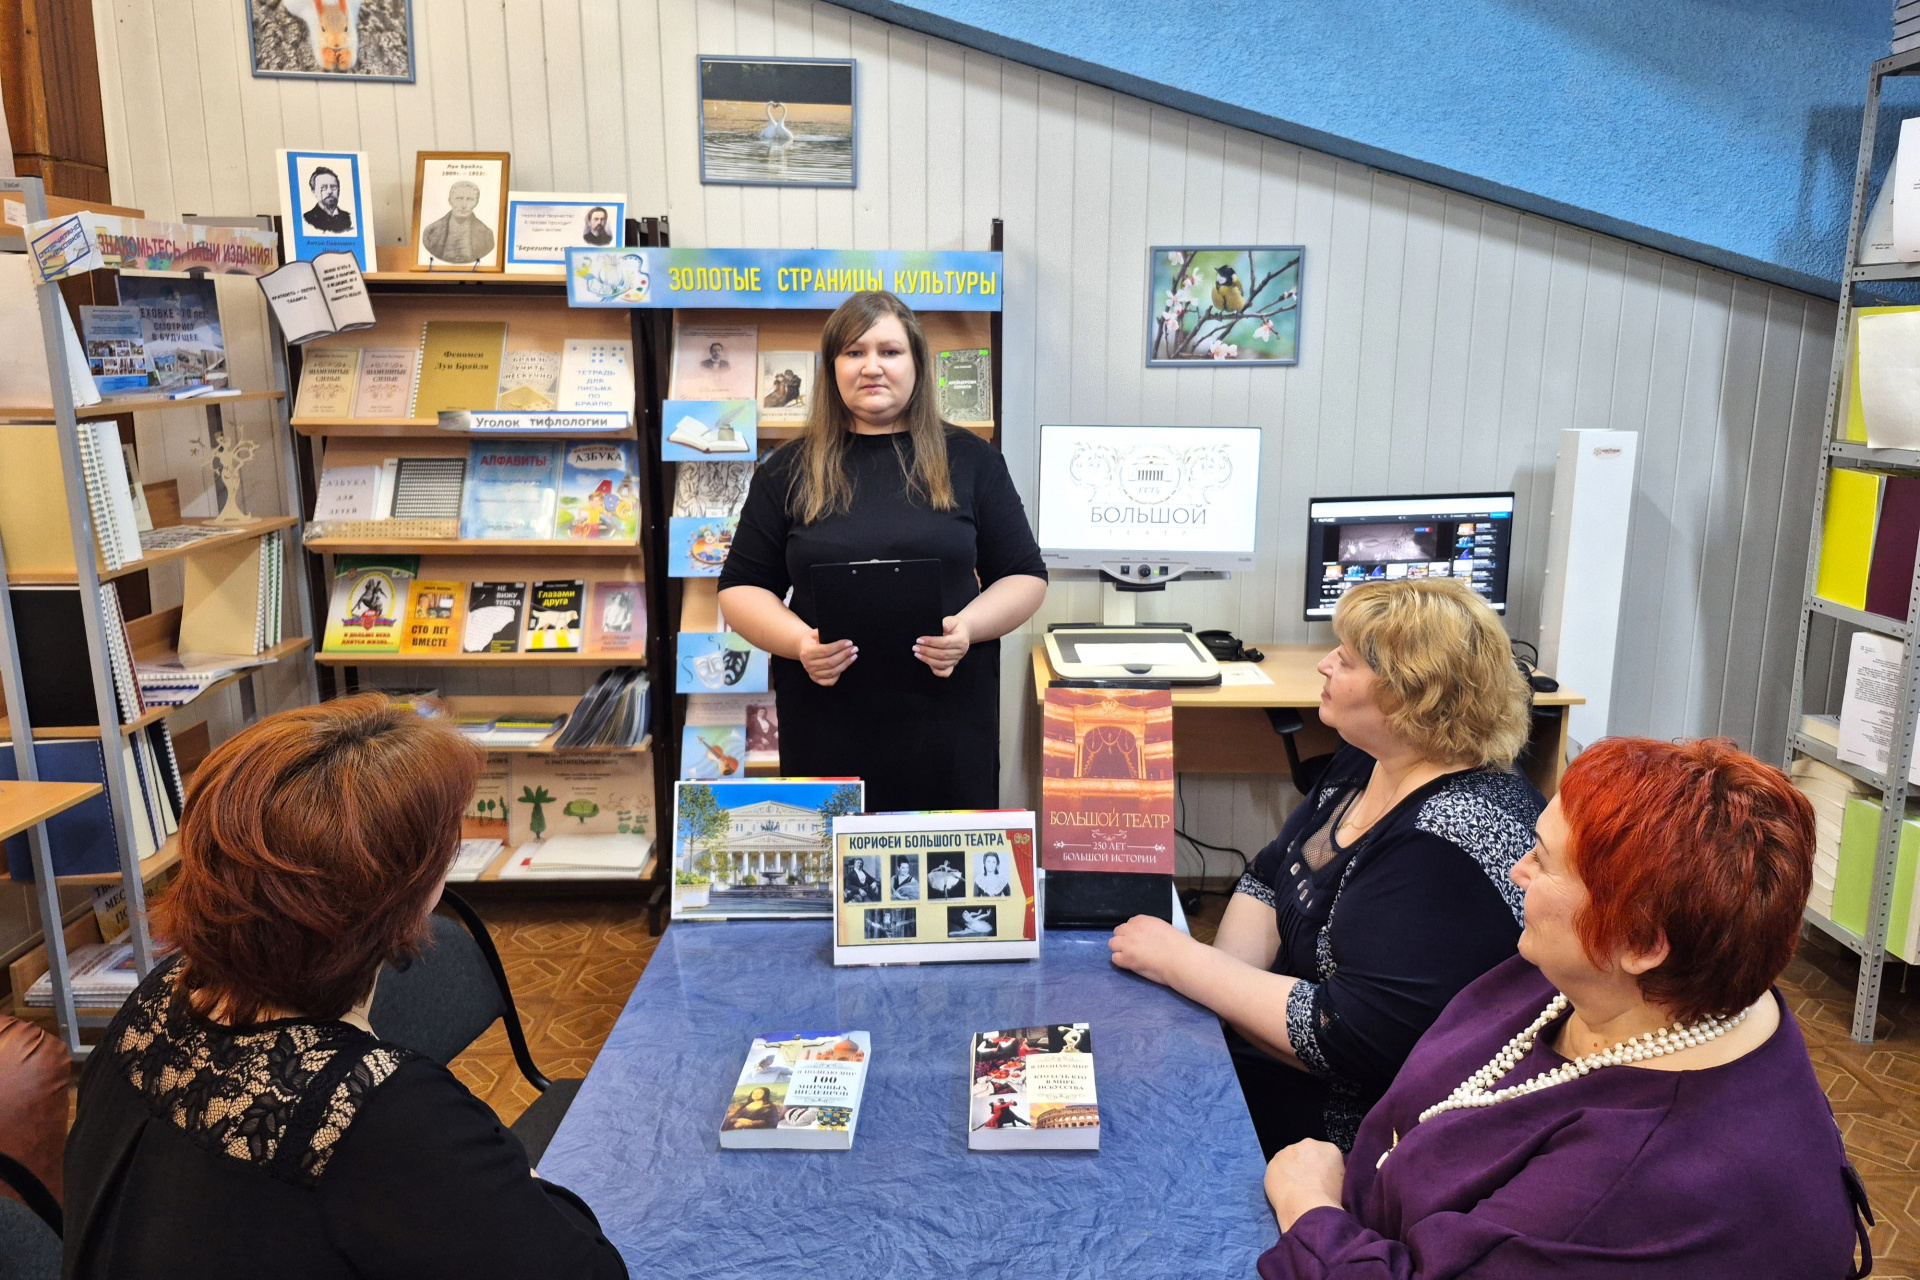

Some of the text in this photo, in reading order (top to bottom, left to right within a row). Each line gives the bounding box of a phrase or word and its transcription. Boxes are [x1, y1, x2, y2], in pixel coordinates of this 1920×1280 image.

[97, 234, 274, 266] ЗНАКОМЬТЕСЬ, НАШИ ИЗДАНИЯ!
[668, 266, 997, 296] ЗОЛОТЫЕ СТРАНИЦЫ КУЛЬТУРЫ
[140, 308, 174, 319] ЕХОВКЕ
[181, 308, 191, 318] 70
[159, 333, 199, 343] БУДУЩЕЕ
[434, 362, 489, 371] Луи Брайля
[476, 416, 608, 429] Уголок тифлологии
[480, 455, 547, 467] АЛФАВИТЫ
[575, 452, 623, 463] АЗБУКА
[326, 479, 367, 487] АЗБУКА
[1090, 504, 1206, 524] БОЛЬШОЙ
[537, 590, 576, 599] Глазами
[542, 598, 569, 607] друга
[411, 625, 450, 634] СТО ЛЕТ
[411, 637, 448, 647] ВМЕСТЕ
[1050, 807, 1170, 828] БОЛЬШОЙ ТЕАТР
[849, 832, 1004, 850] КОРИФЕИ БОЛЬШОГО ТЕАТРА
[1093, 841, 1126, 851] 250 ЛЕТ
[1062, 851, 1157, 863] БОЛЬШОЙ ИСТОРИИ
[813, 1075, 838, 1084] 100
